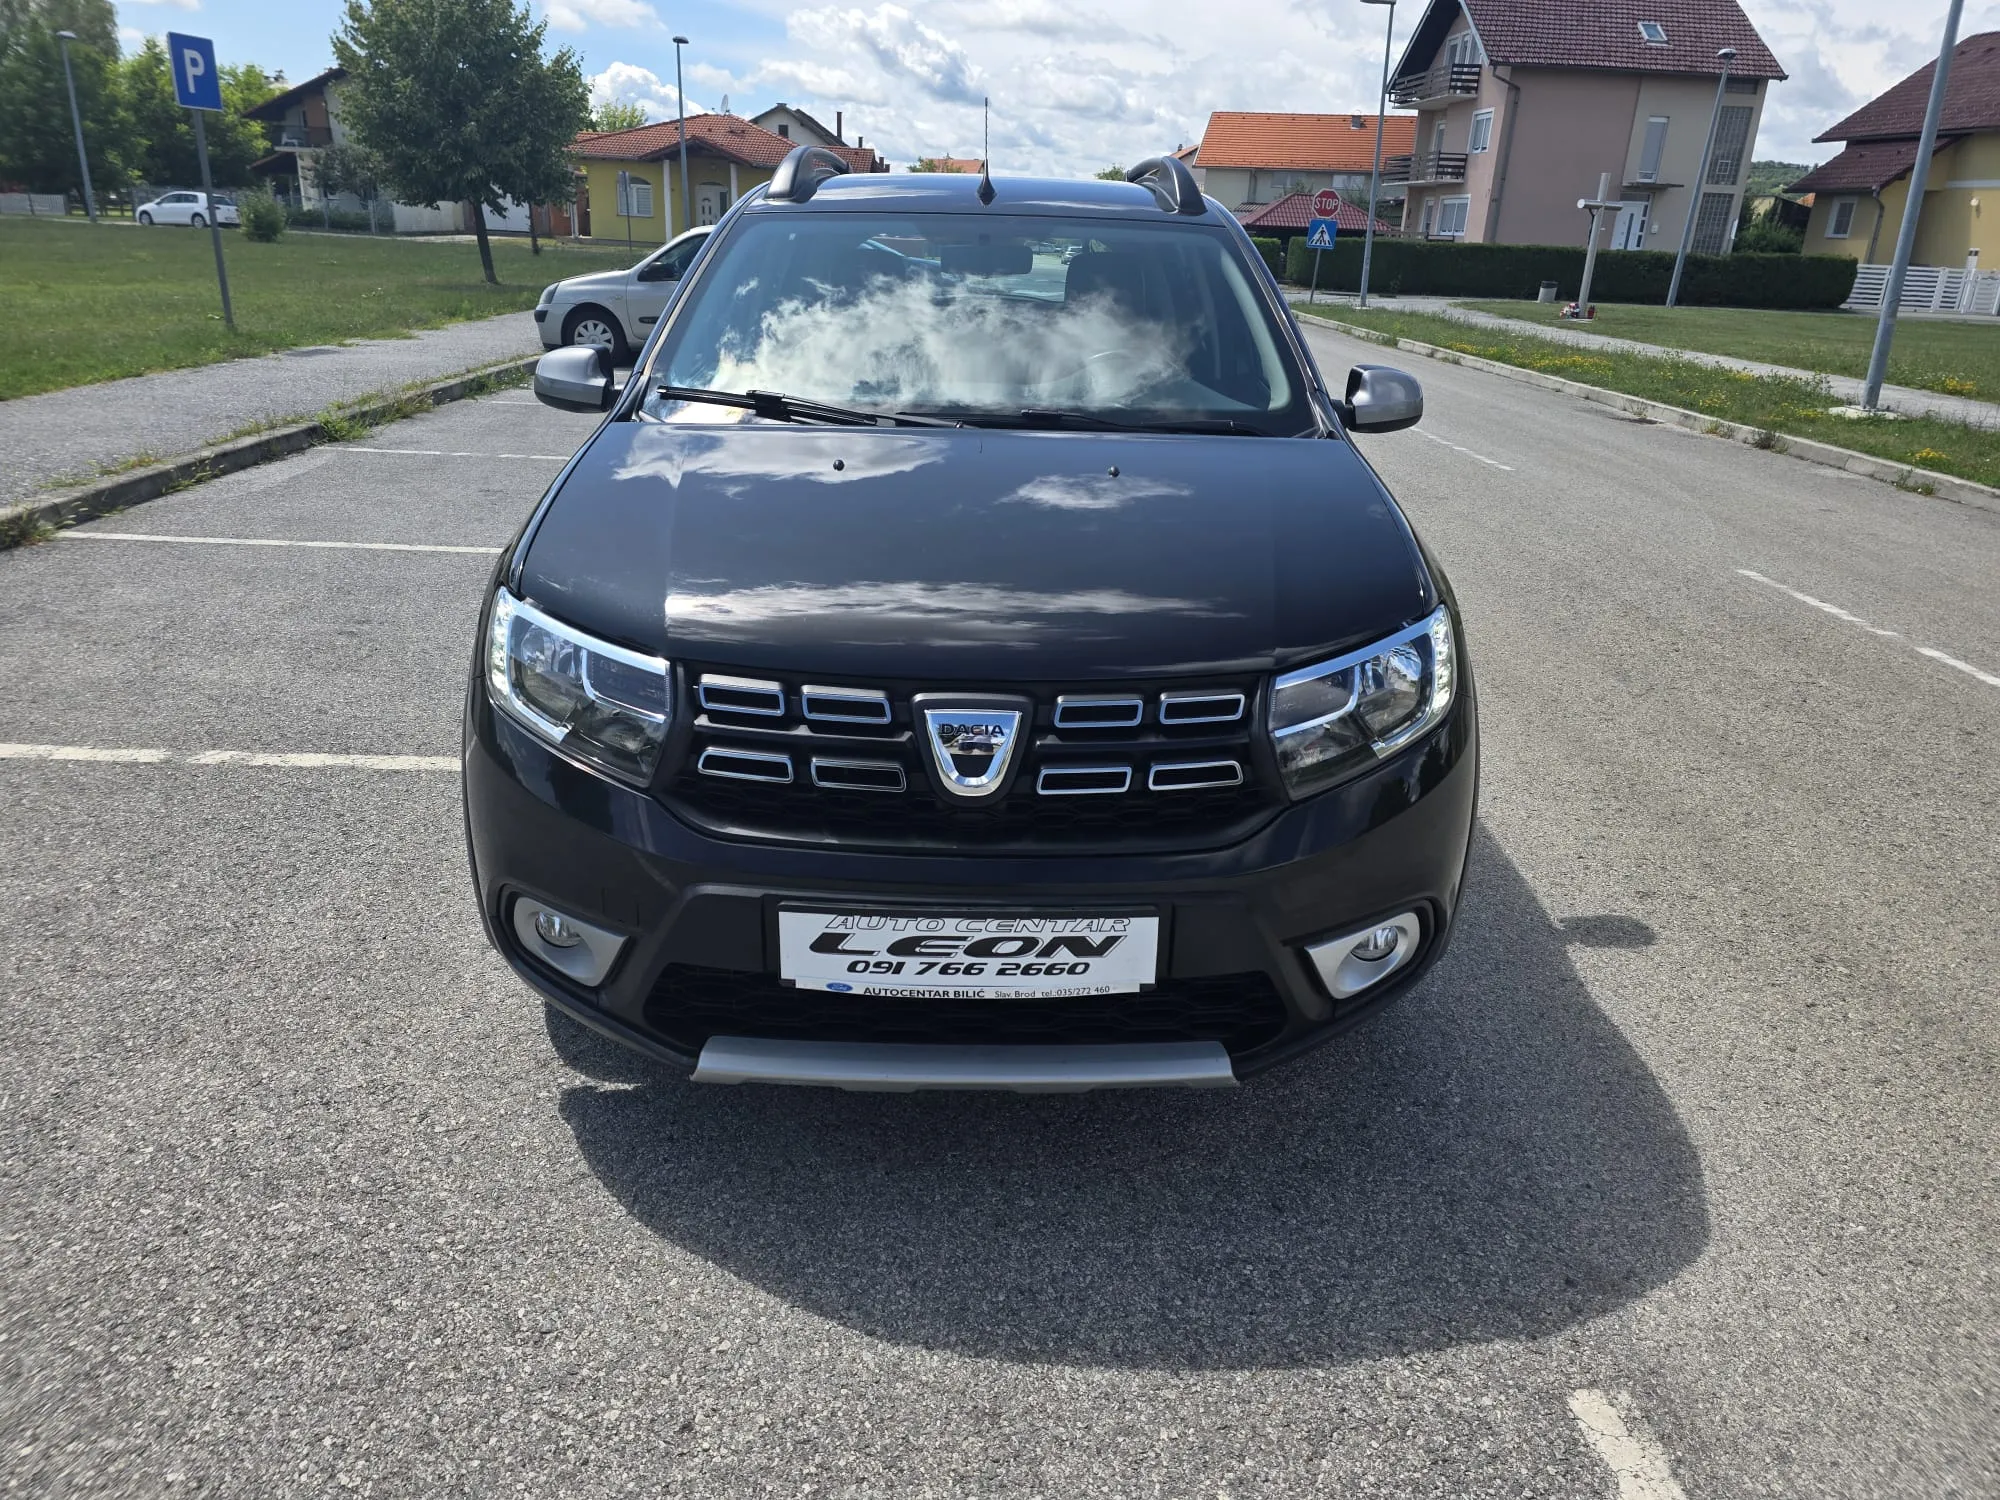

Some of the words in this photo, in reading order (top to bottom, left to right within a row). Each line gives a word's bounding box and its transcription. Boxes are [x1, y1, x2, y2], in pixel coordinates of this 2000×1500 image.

[183, 48, 205, 94] P
[1314, 198, 1339, 210] STOP
[940, 723, 1005, 737] DACIA
[825, 914, 946, 932] AUTO
[955, 918, 1131, 932] CENTAR
[809, 932, 1128, 959] LEON
[846, 960, 906, 975] 091
[914, 962, 988, 976] 766
[995, 962, 1091, 976] 2660
[863, 987, 950, 998] AUTOCENTAR
[953, 988, 985, 998] BILIĆ
[1014, 990, 1036, 998] Brod
[1094, 985, 1110, 994] 460
